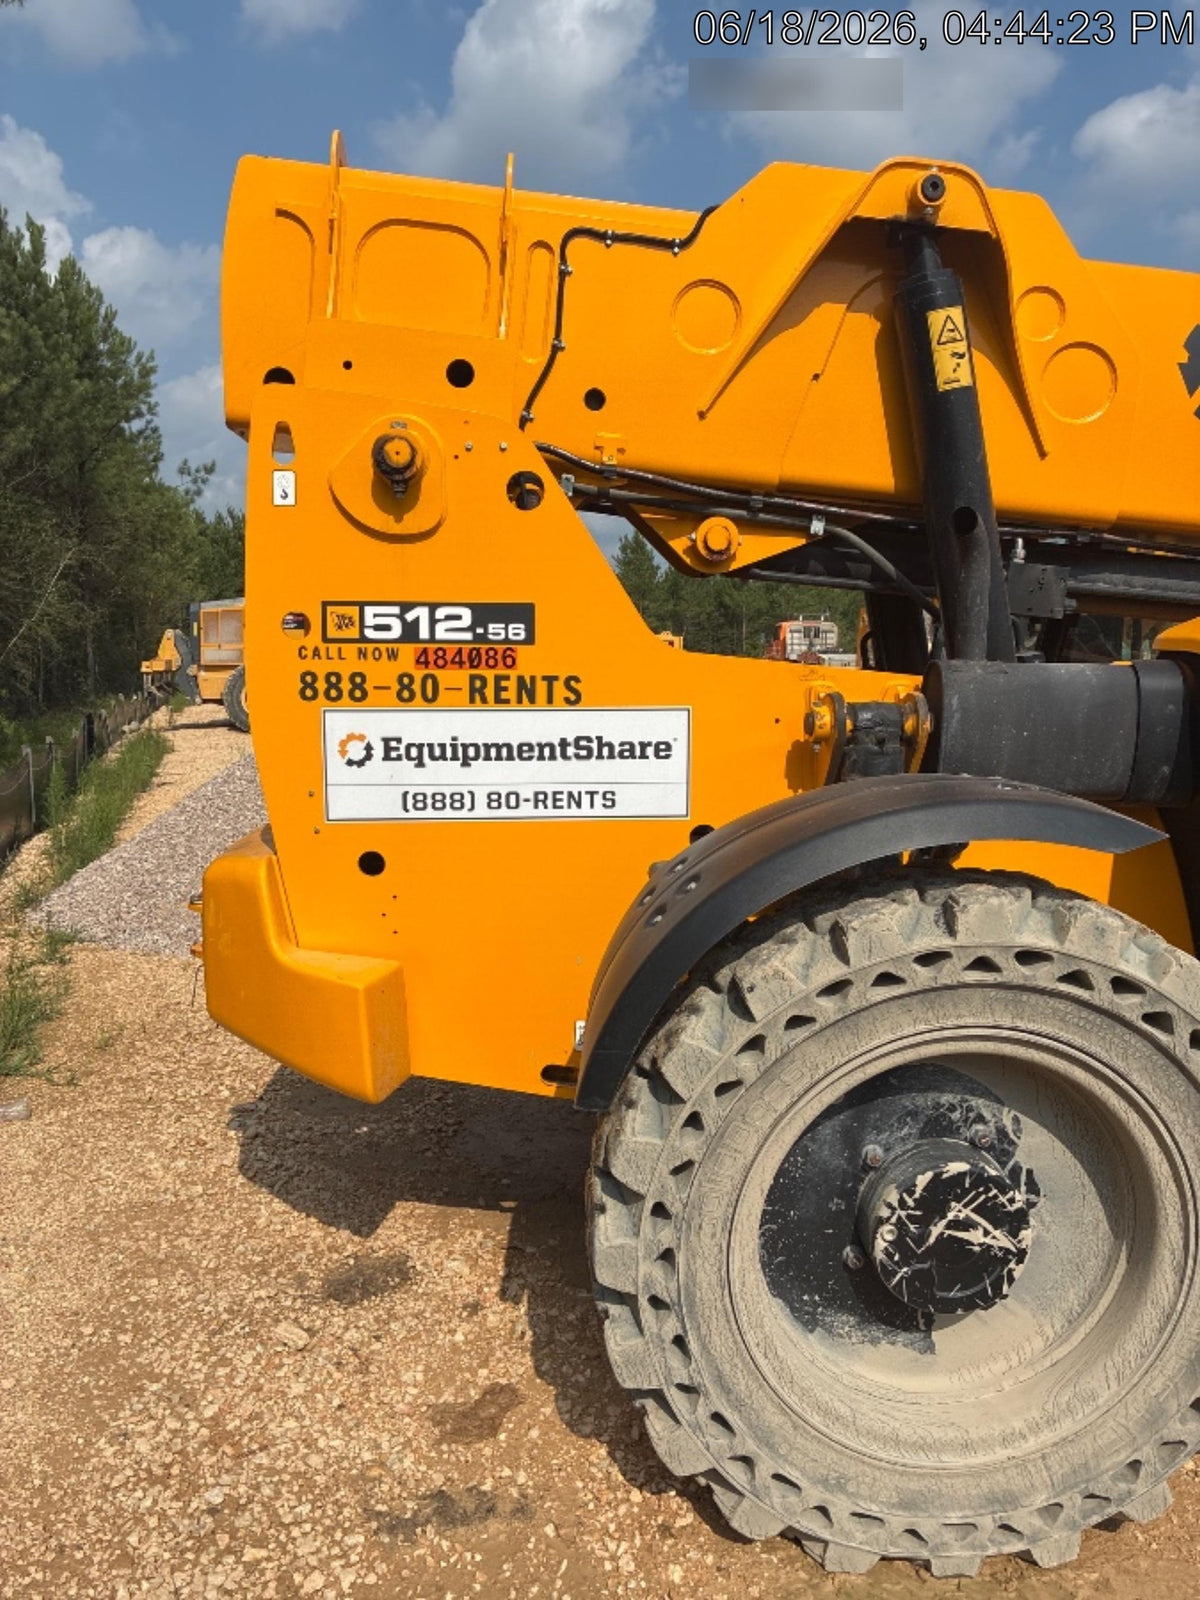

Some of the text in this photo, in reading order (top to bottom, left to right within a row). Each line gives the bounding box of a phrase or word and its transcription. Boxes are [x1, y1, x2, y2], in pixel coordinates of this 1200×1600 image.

[363, 606, 528, 641] 512-56
[298, 645, 400, 662] CALL NOW
[415, 647, 518, 669] 484086
[299, 671, 582, 705] 888-80-RENTS
[381, 735, 673, 768] EquipmentShare
[401, 790, 617, 813] (888) 80-RENTS
